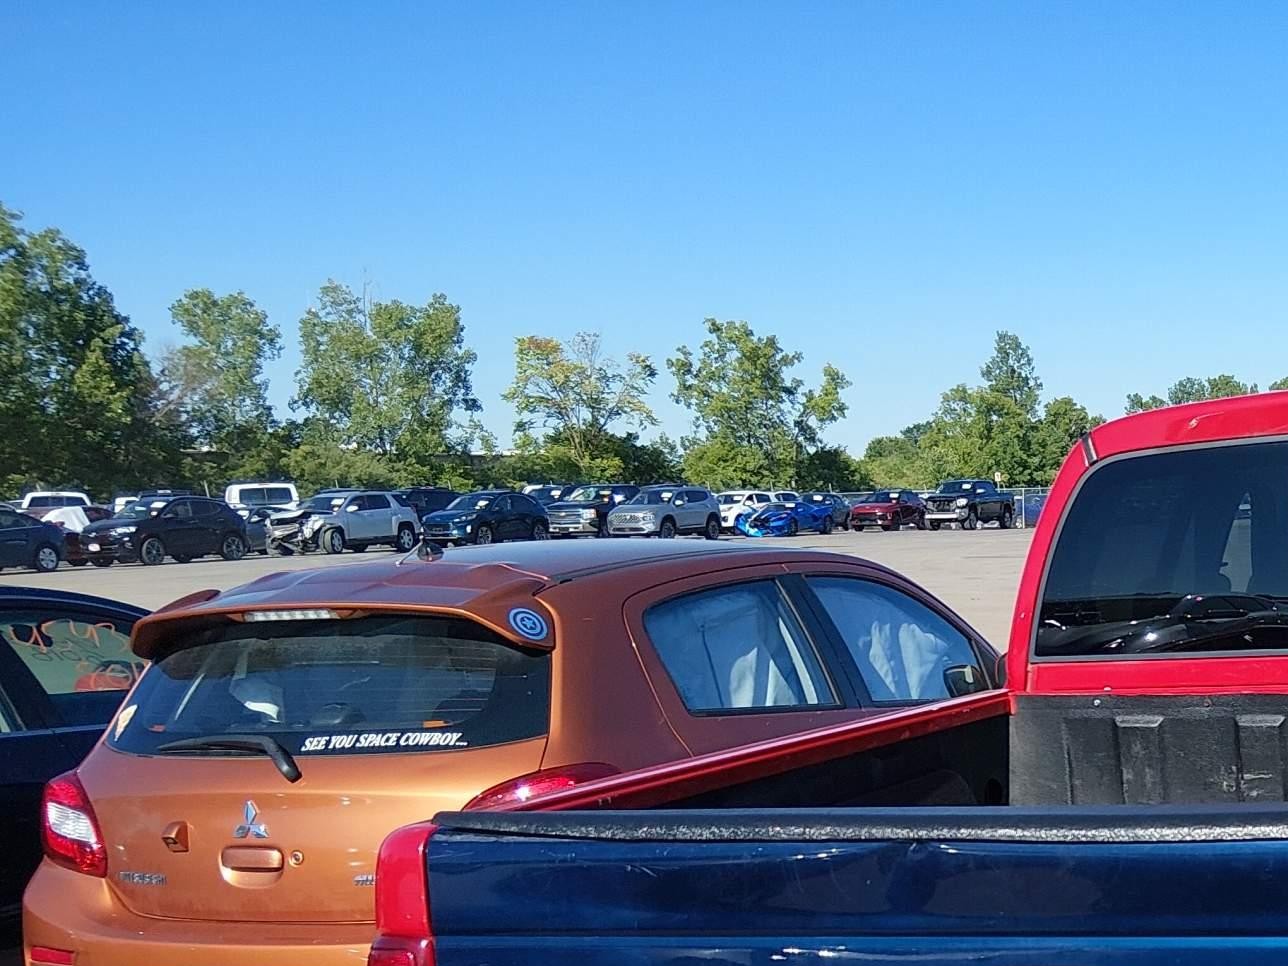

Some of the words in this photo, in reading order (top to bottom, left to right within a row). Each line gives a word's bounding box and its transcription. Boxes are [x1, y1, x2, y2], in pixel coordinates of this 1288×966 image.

[301, 736, 331, 751] SEE
[328, 734, 358, 749] YOU
[356, 733, 401, 748] SPACE
[395, 732, 468, 746] COWBOY...
